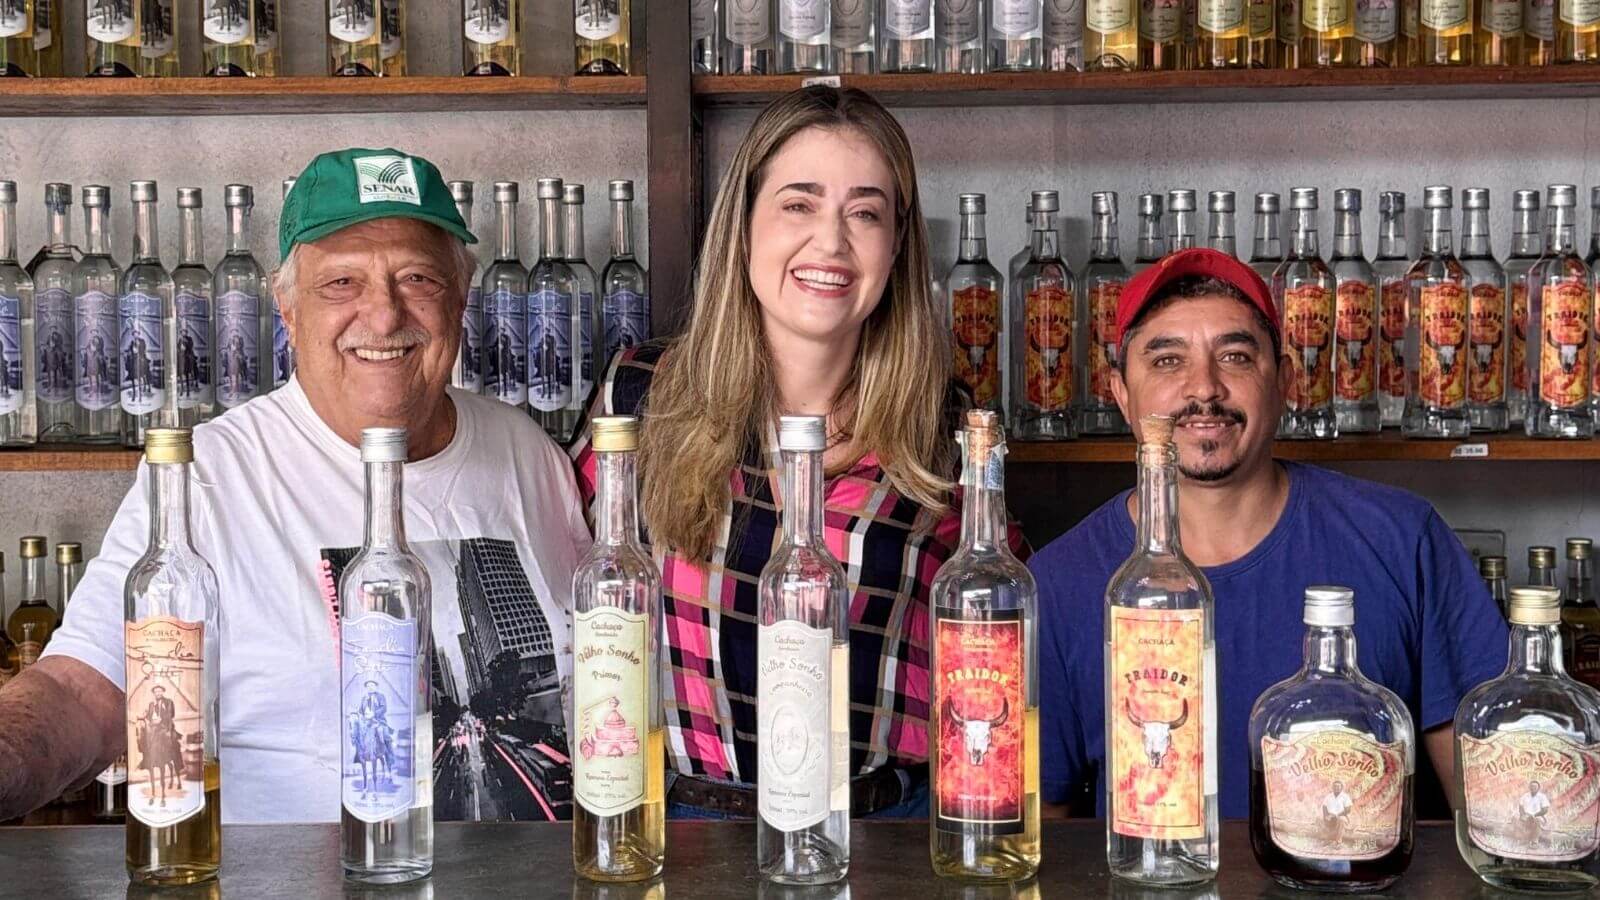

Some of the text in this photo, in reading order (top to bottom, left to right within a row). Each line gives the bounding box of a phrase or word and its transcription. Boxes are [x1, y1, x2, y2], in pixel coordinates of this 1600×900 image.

[363, 184, 415, 196] SENAR
[607, 644, 641, 665] Sonho
[789, 657, 823, 680] Sonho
[946, 667, 1010, 688] TRAIDOR
[1124, 668, 1188, 687] TRAIDOR
[1288, 751, 1380, 778] Velho Sonho
[1485, 751, 1579, 779] Velho Sonho
